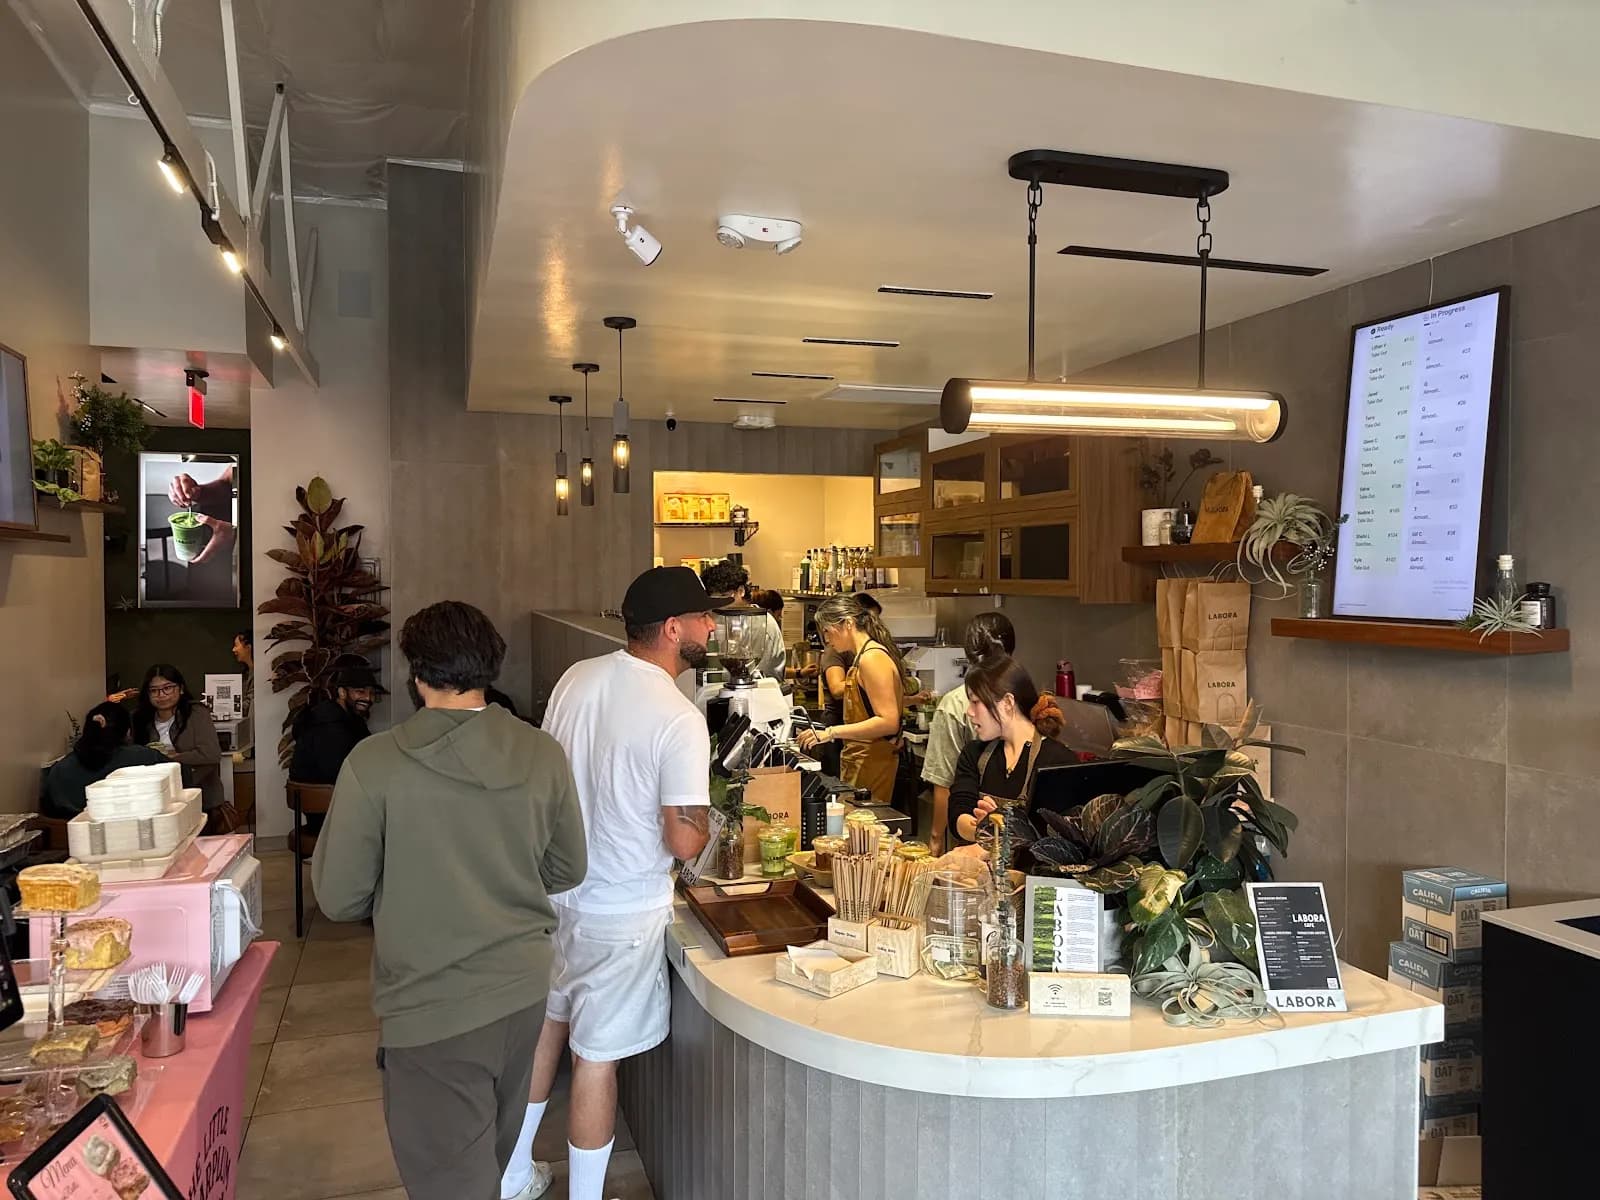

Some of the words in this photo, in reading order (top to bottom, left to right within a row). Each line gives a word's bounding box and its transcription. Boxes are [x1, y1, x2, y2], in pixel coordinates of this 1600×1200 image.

[1438, 305, 1466, 318] Progress
[1376, 324, 1394, 333] Ready
[1208, 611, 1238, 621] LABORA
[1207, 681, 1236, 689] LABORA
[1412, 888, 1444, 904] CALIFIA
[1470, 887, 1492, 896] CALIFIA
[1291, 913, 1326, 923] LABORA
[1460, 908, 1479, 921] OAT
[1408, 927, 1425, 942] OAT
[1398, 958, 1430, 978] CALIFIA
[1276, 996, 1336, 1007] LABORA
[1447, 993, 1465, 1006] OAT
[1434, 1066, 1454, 1078] OAT
[204, 1105, 229, 1162] LITTLE
[41, 1156, 79, 1189] Menu
